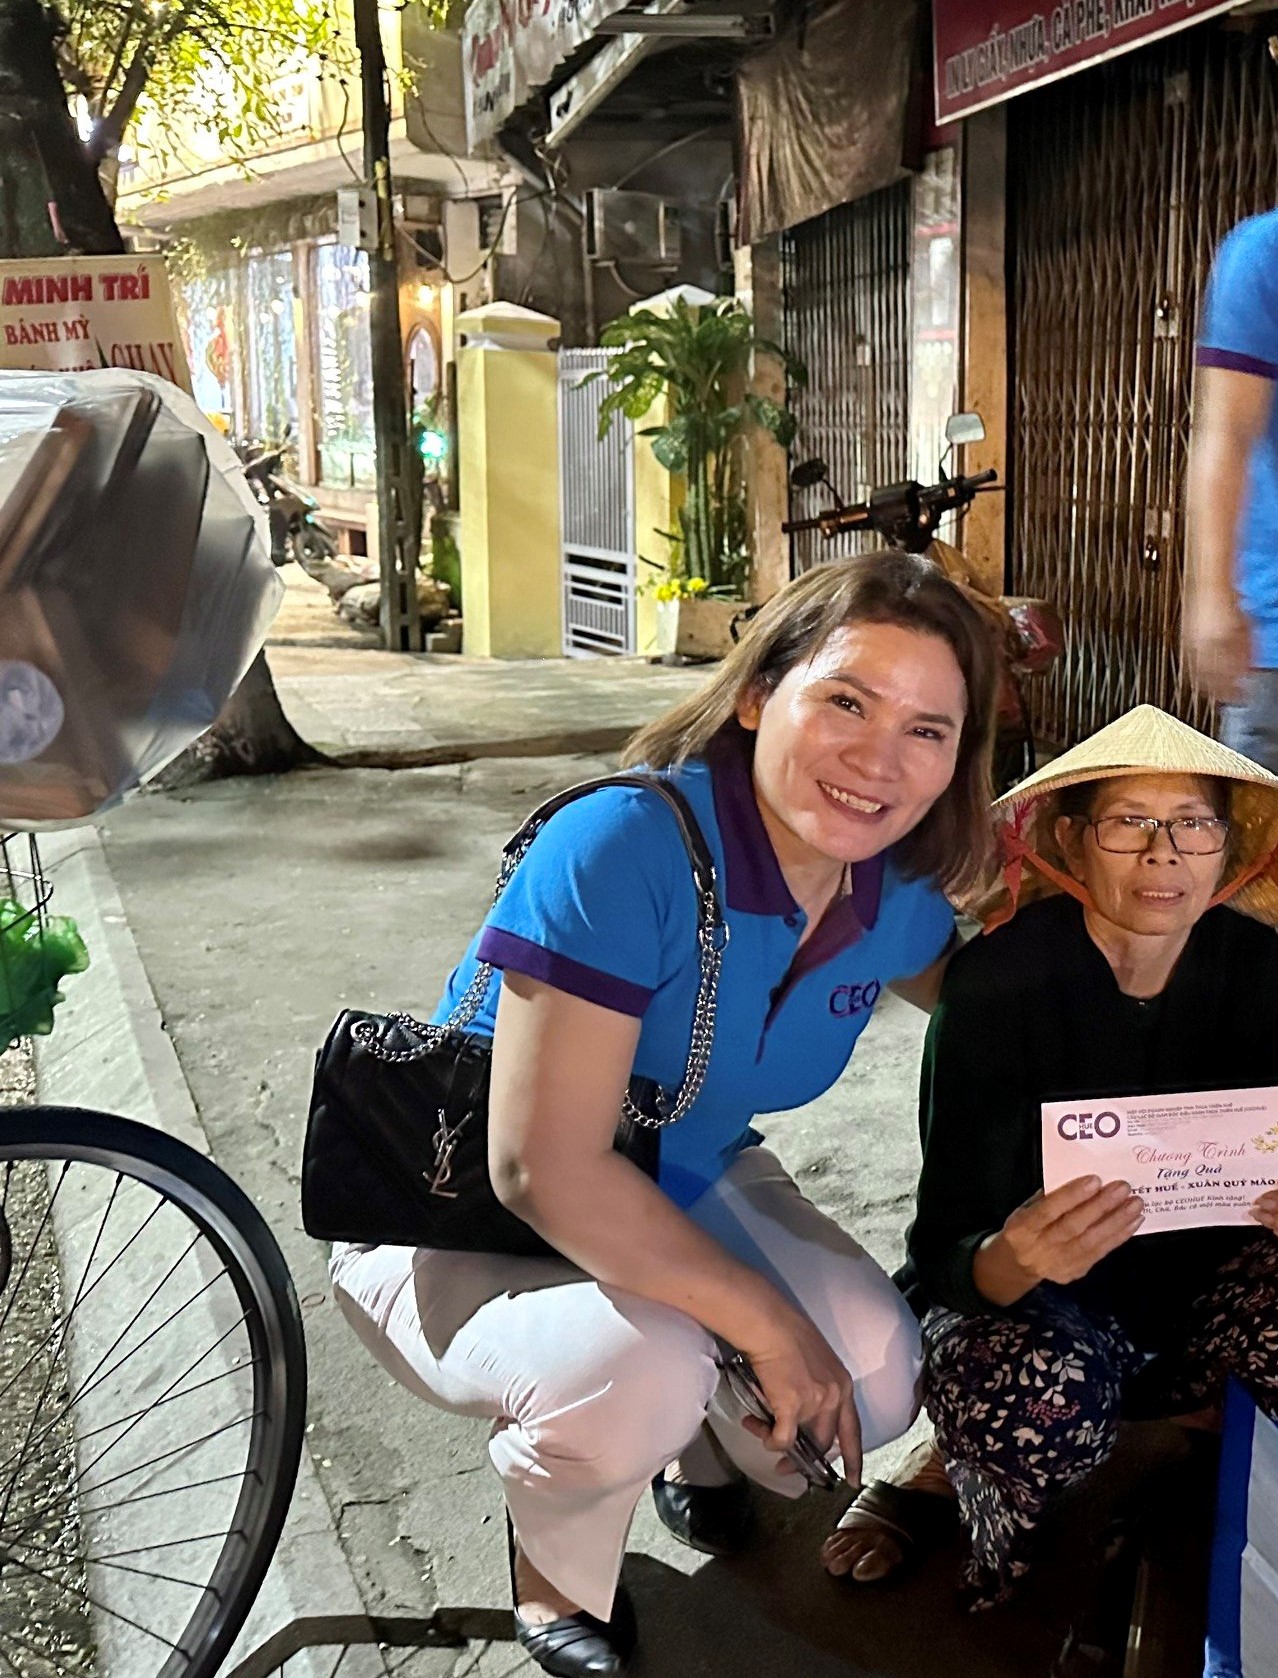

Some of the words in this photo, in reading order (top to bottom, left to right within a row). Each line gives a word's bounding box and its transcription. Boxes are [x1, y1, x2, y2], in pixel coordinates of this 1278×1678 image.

[3, 274, 94, 306] MINH
[99, 263, 150, 301] TRÍ
[4, 318, 61, 345] BÁNH
[829, 978, 881, 1018] CEO
[1057, 1111, 1121, 1141] CEO
[1132, 1145, 1193, 1167] Chương
[1197, 1141, 1246, 1160] Trình
[1157, 1167, 1190, 1180] Tặng
[1195, 1163, 1223, 1176] Quà
[1131, 1183, 1152, 1195] TẾT
[1154, 1182, 1179, 1193] HUẾ
[1187, 1179, 1220, 1190] XUÂN
[1250, 1177, 1276, 1187] MÃO
